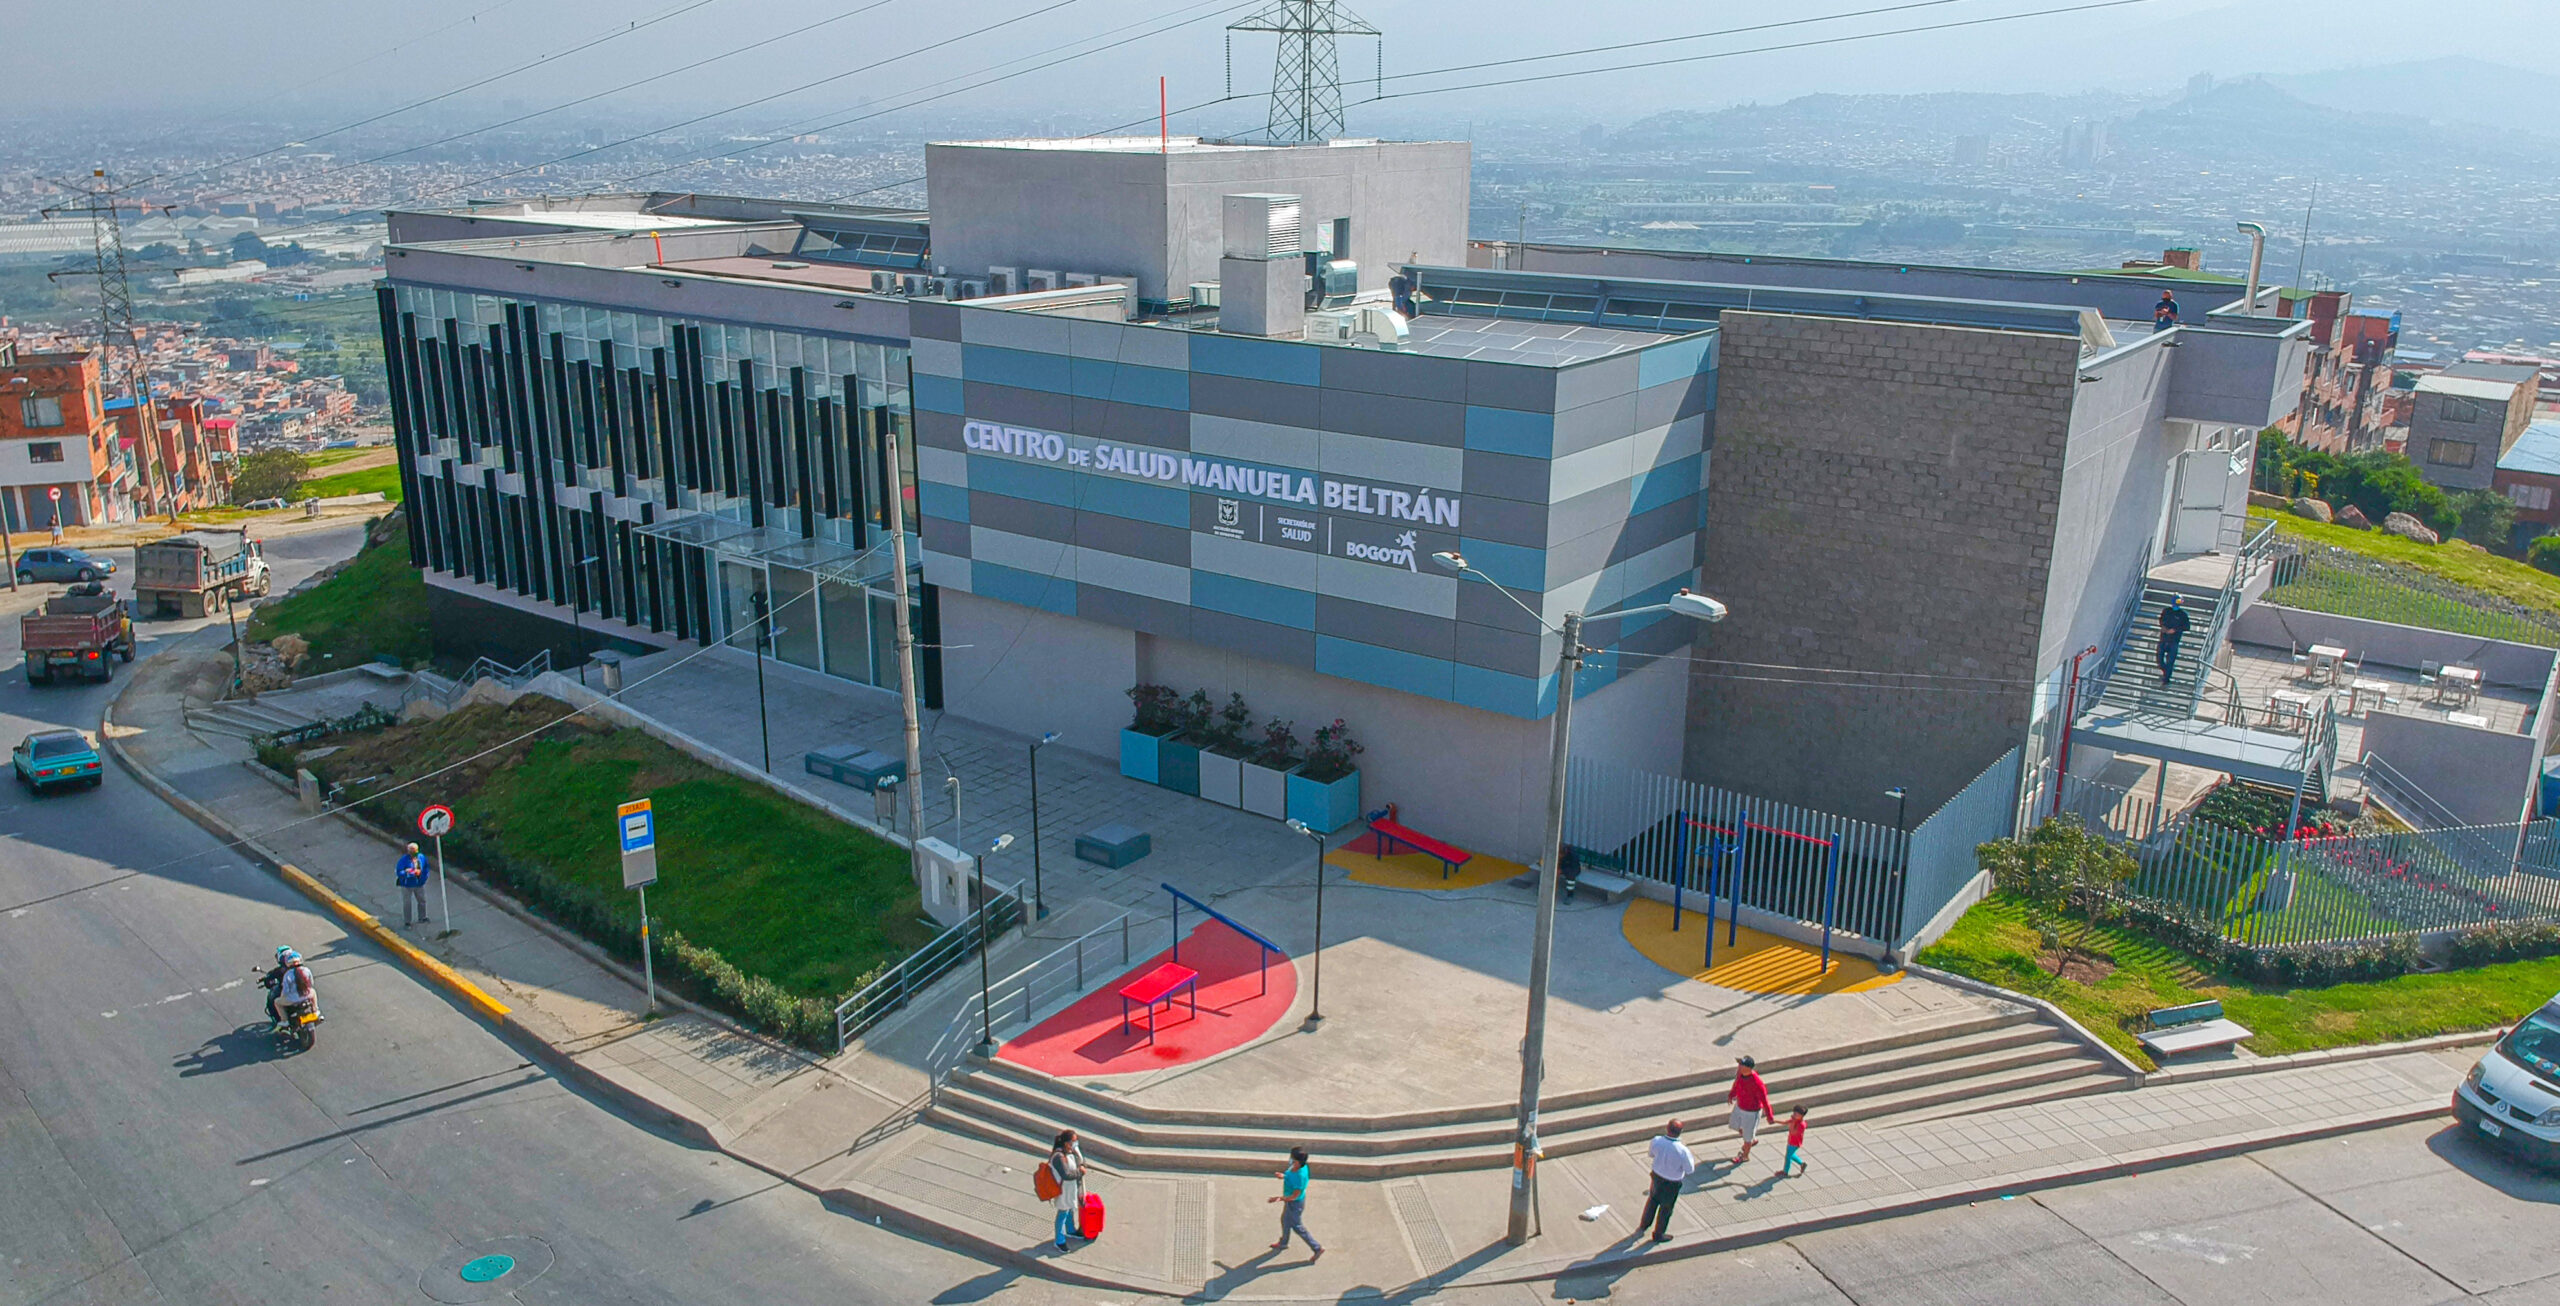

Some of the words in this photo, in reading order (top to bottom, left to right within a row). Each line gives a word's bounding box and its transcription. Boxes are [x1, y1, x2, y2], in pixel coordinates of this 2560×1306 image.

[963, 421, 1065, 462] CENTRO
[1067, 447, 1091, 467] DE
[1095, 444, 1178, 481] SALUD
[1181, 458, 1318, 505] MANUELA
[1323, 480, 1460, 528] BELTRÁN
[1281, 527, 1312, 542] SALUD
